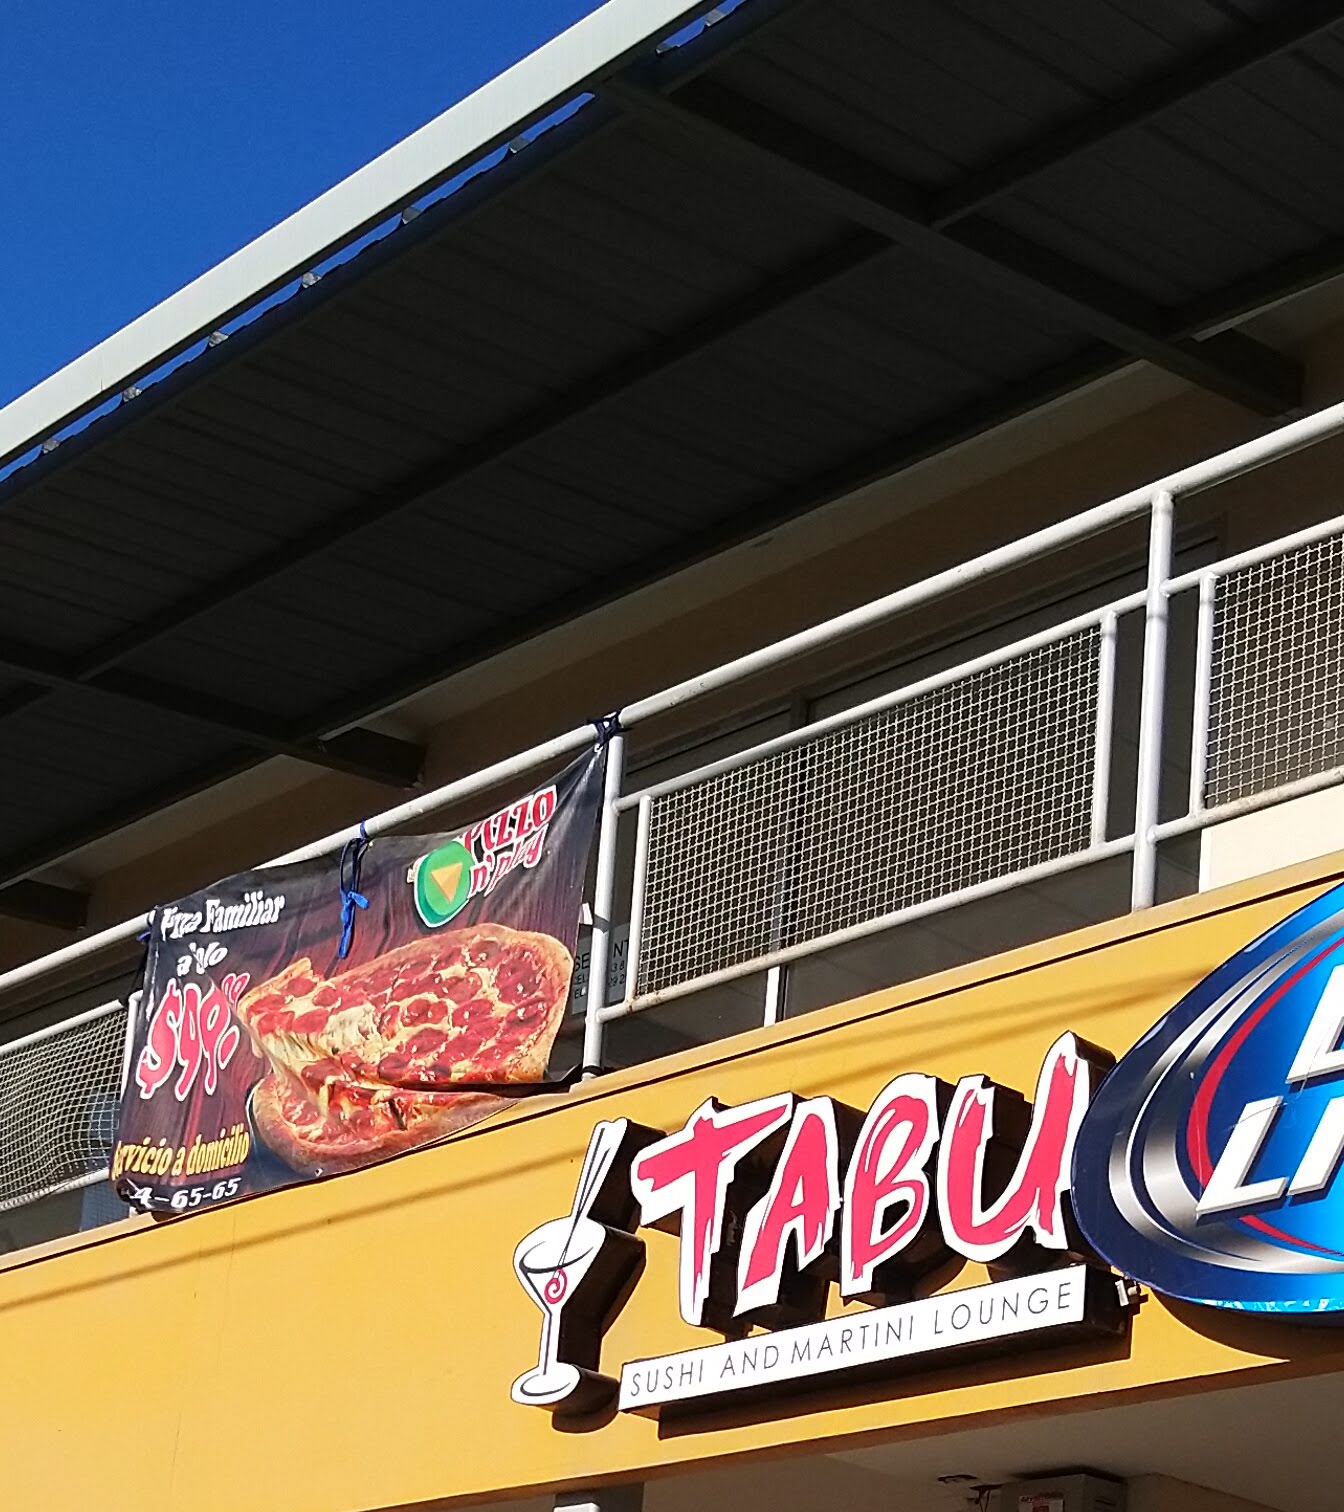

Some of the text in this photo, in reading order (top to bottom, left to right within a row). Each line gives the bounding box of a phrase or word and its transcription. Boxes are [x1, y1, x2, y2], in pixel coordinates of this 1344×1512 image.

[464, 788, 555, 853] Pizza
[199, 890, 286, 933] Familiar
[177, 955, 192, 976] a
[171, 1147, 186, 1176] a
[186, 1123, 250, 1176] domicilio
[633, 1033, 1087, 1324] TABU
[630, 1282, 1073, 1397] SUSHI AND MARTINI LOUNGE
